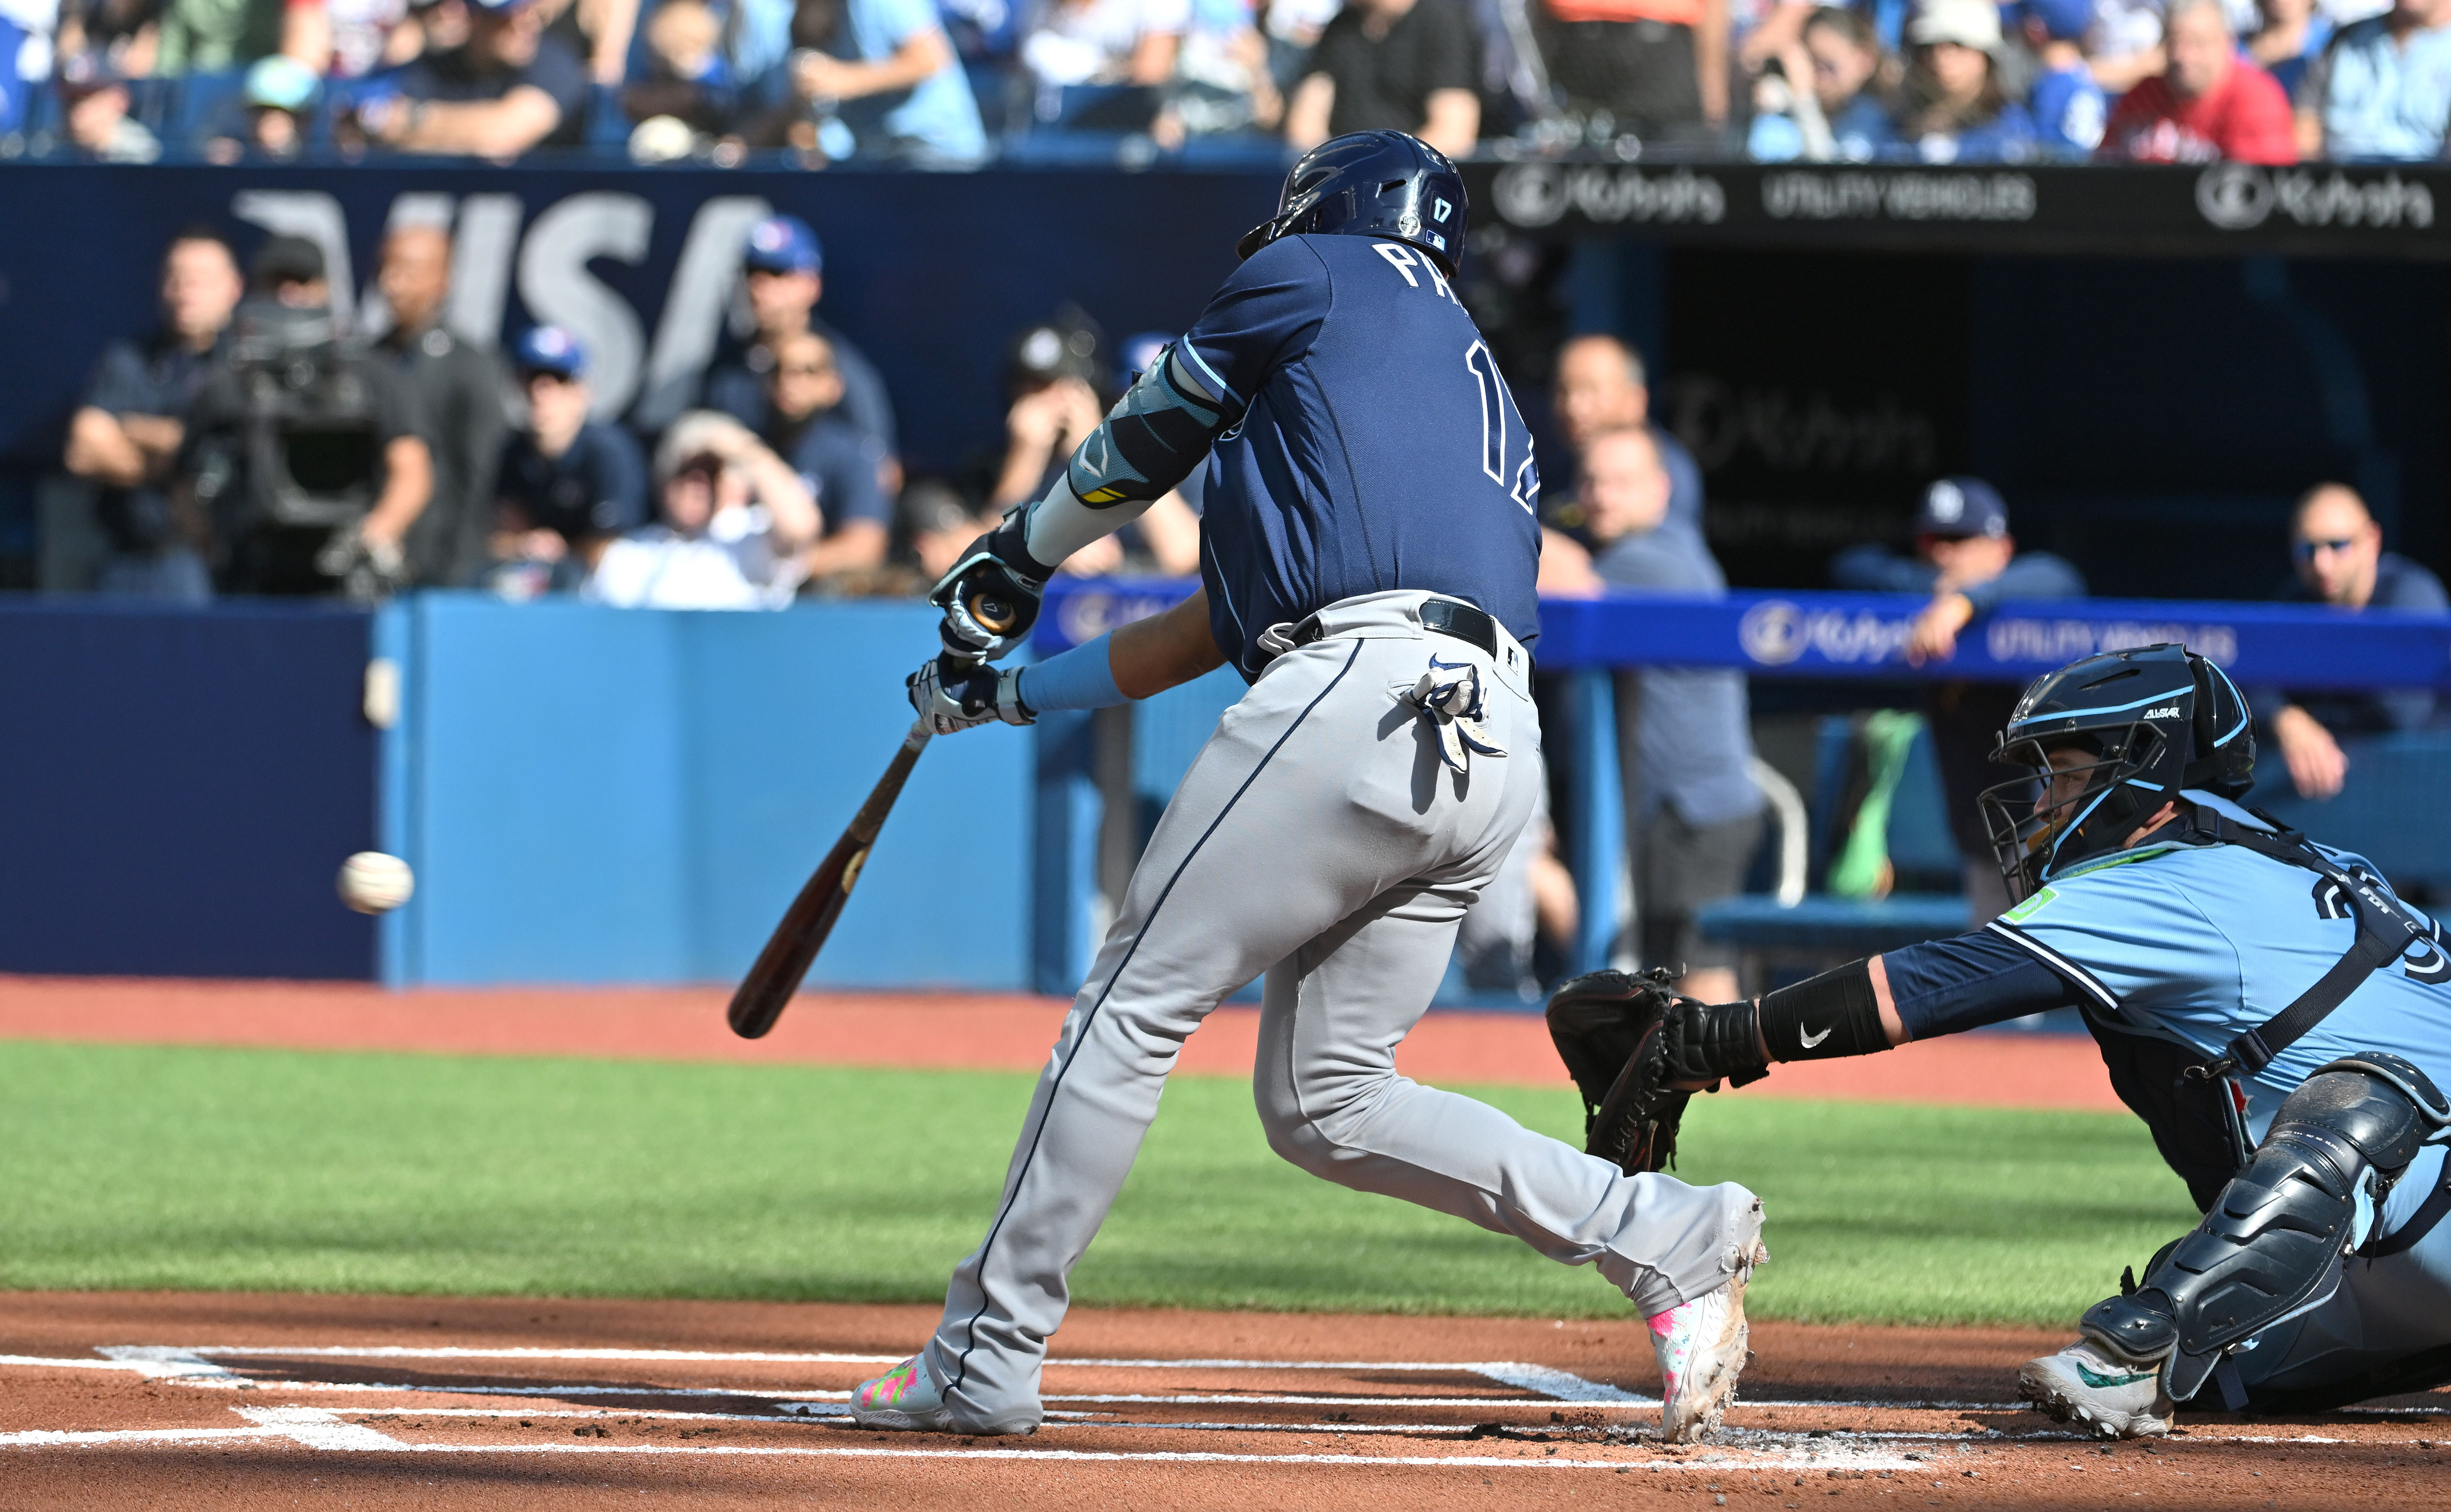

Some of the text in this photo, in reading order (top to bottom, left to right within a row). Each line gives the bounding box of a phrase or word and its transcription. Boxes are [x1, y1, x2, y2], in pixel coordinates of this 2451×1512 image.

[1434, 197, 1452, 223] 17
[2273, 167, 2434, 229] Kubota
[231, 190, 775, 430] VISA
[1805, 607, 1912, 664] Kubo
[2144, 707, 2180, 719] ALL-STAR
